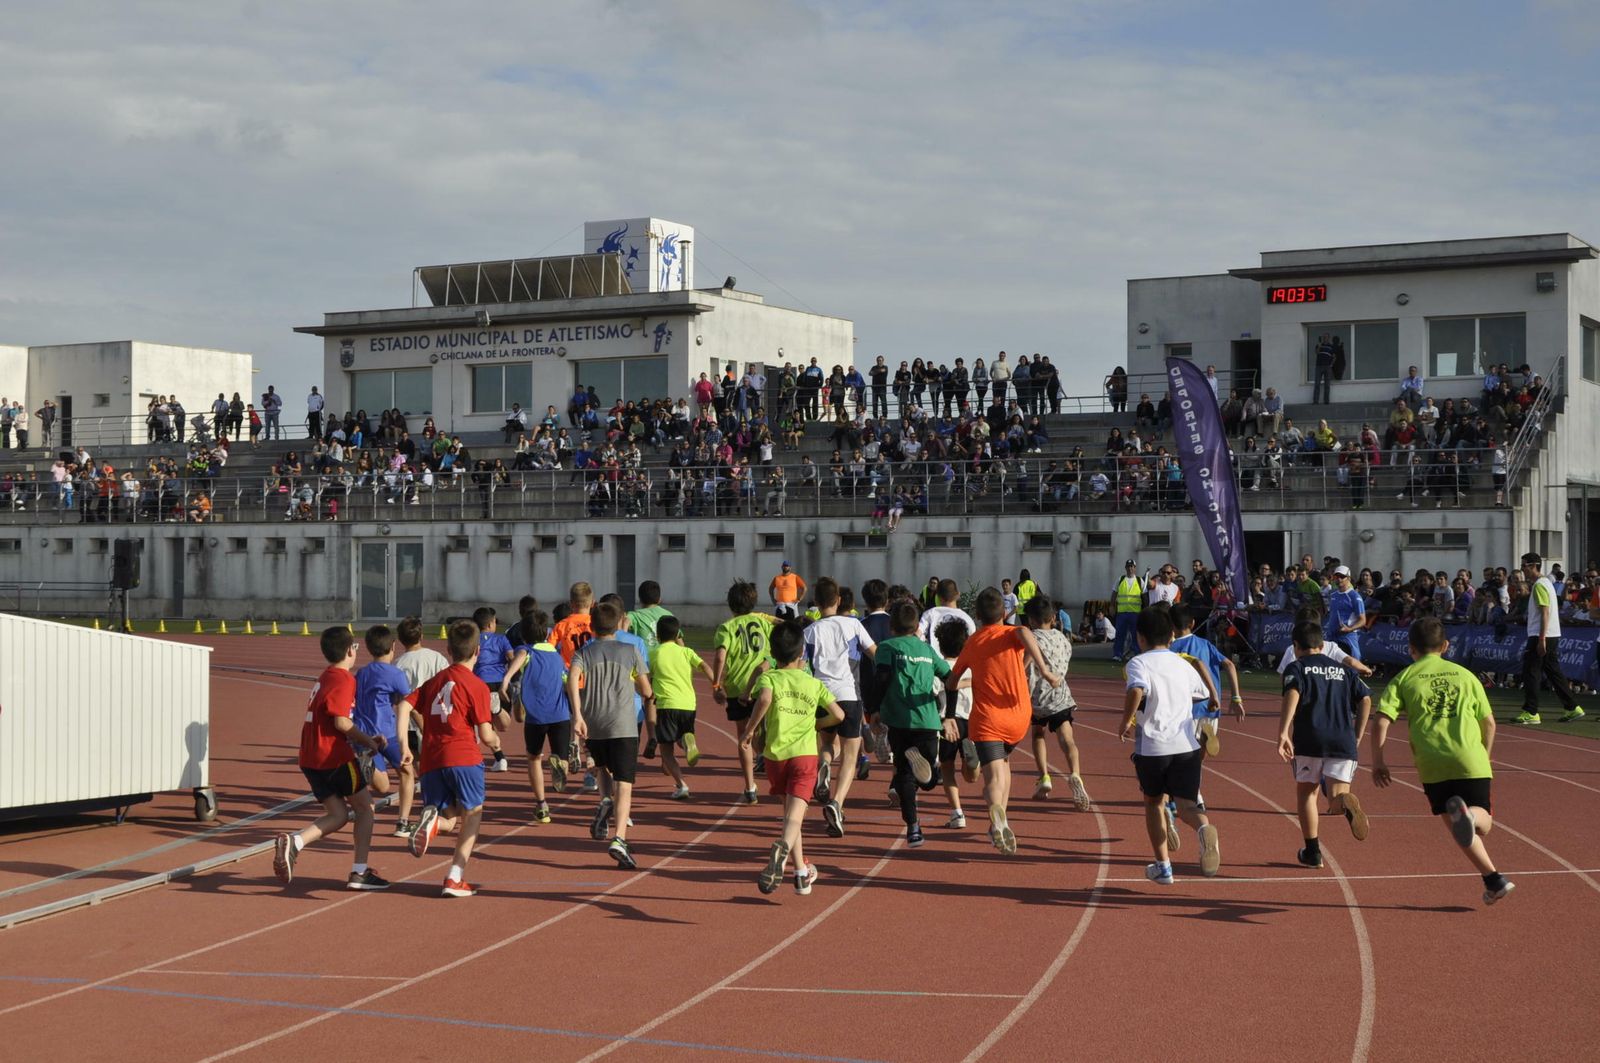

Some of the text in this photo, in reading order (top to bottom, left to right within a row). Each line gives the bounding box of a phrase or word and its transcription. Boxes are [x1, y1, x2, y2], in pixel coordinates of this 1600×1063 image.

[370, 323, 633, 352] ESTADIO MUNICIPAL DE ATLETISMO
[440, 346, 556, 361] CHICLANA DE LA FRONTERA
[735, 621, 765, 655] 16
[1304, 665, 1345, 676] POLICIA
[1325, 673, 1344, 681] LOCAL
[430, 680, 457, 724] 4
